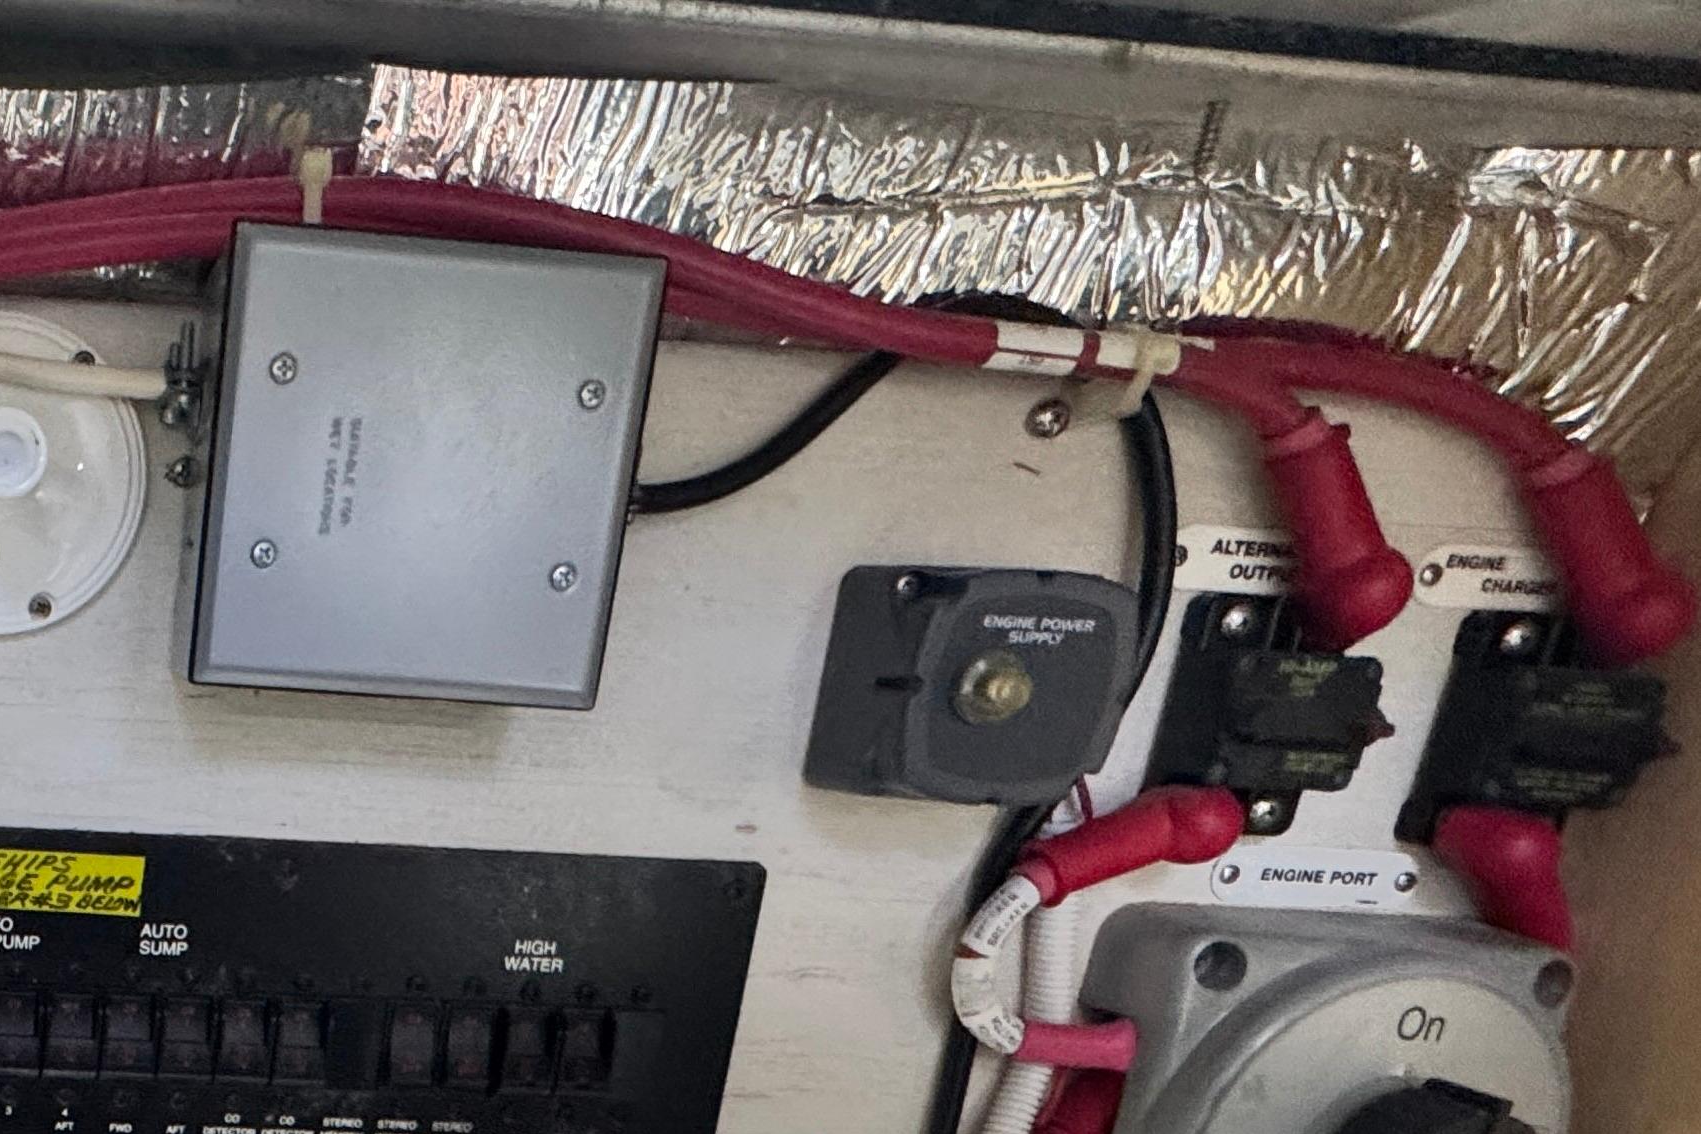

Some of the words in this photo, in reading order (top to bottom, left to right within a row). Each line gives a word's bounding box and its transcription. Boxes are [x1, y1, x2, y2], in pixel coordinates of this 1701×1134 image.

[1446, 554, 1506, 571] ENGINE
[983, 614, 1036, 630] ENGINE
[1040, 617, 1096, 633] POWER
[1008, 630, 1065, 645] SUPPLY
[45, 872, 136, 895] PUMP
[1260, 868, 1325, 884] ENGINE
[1329, 871, 1378, 886] PORT
[140, 923, 189, 939] AUTO
[139, 939, 189, 956] SUMP
[514, 939, 557, 955] HIGH
[504, 956, 564, 973] WATER
[1397, 1005, 1447, 1042] On
[5, 1105, 12, 1115] 3
[61, 1107, 69, 1117] 4
[54, 1121, 74, 1132] AFT
[224, 1113, 241, 1124] CO
[279, 1115, 295, 1126] CO
[322, 1117, 364, 1129] STEREO
[109, 1123, 133, 1134] FWD
